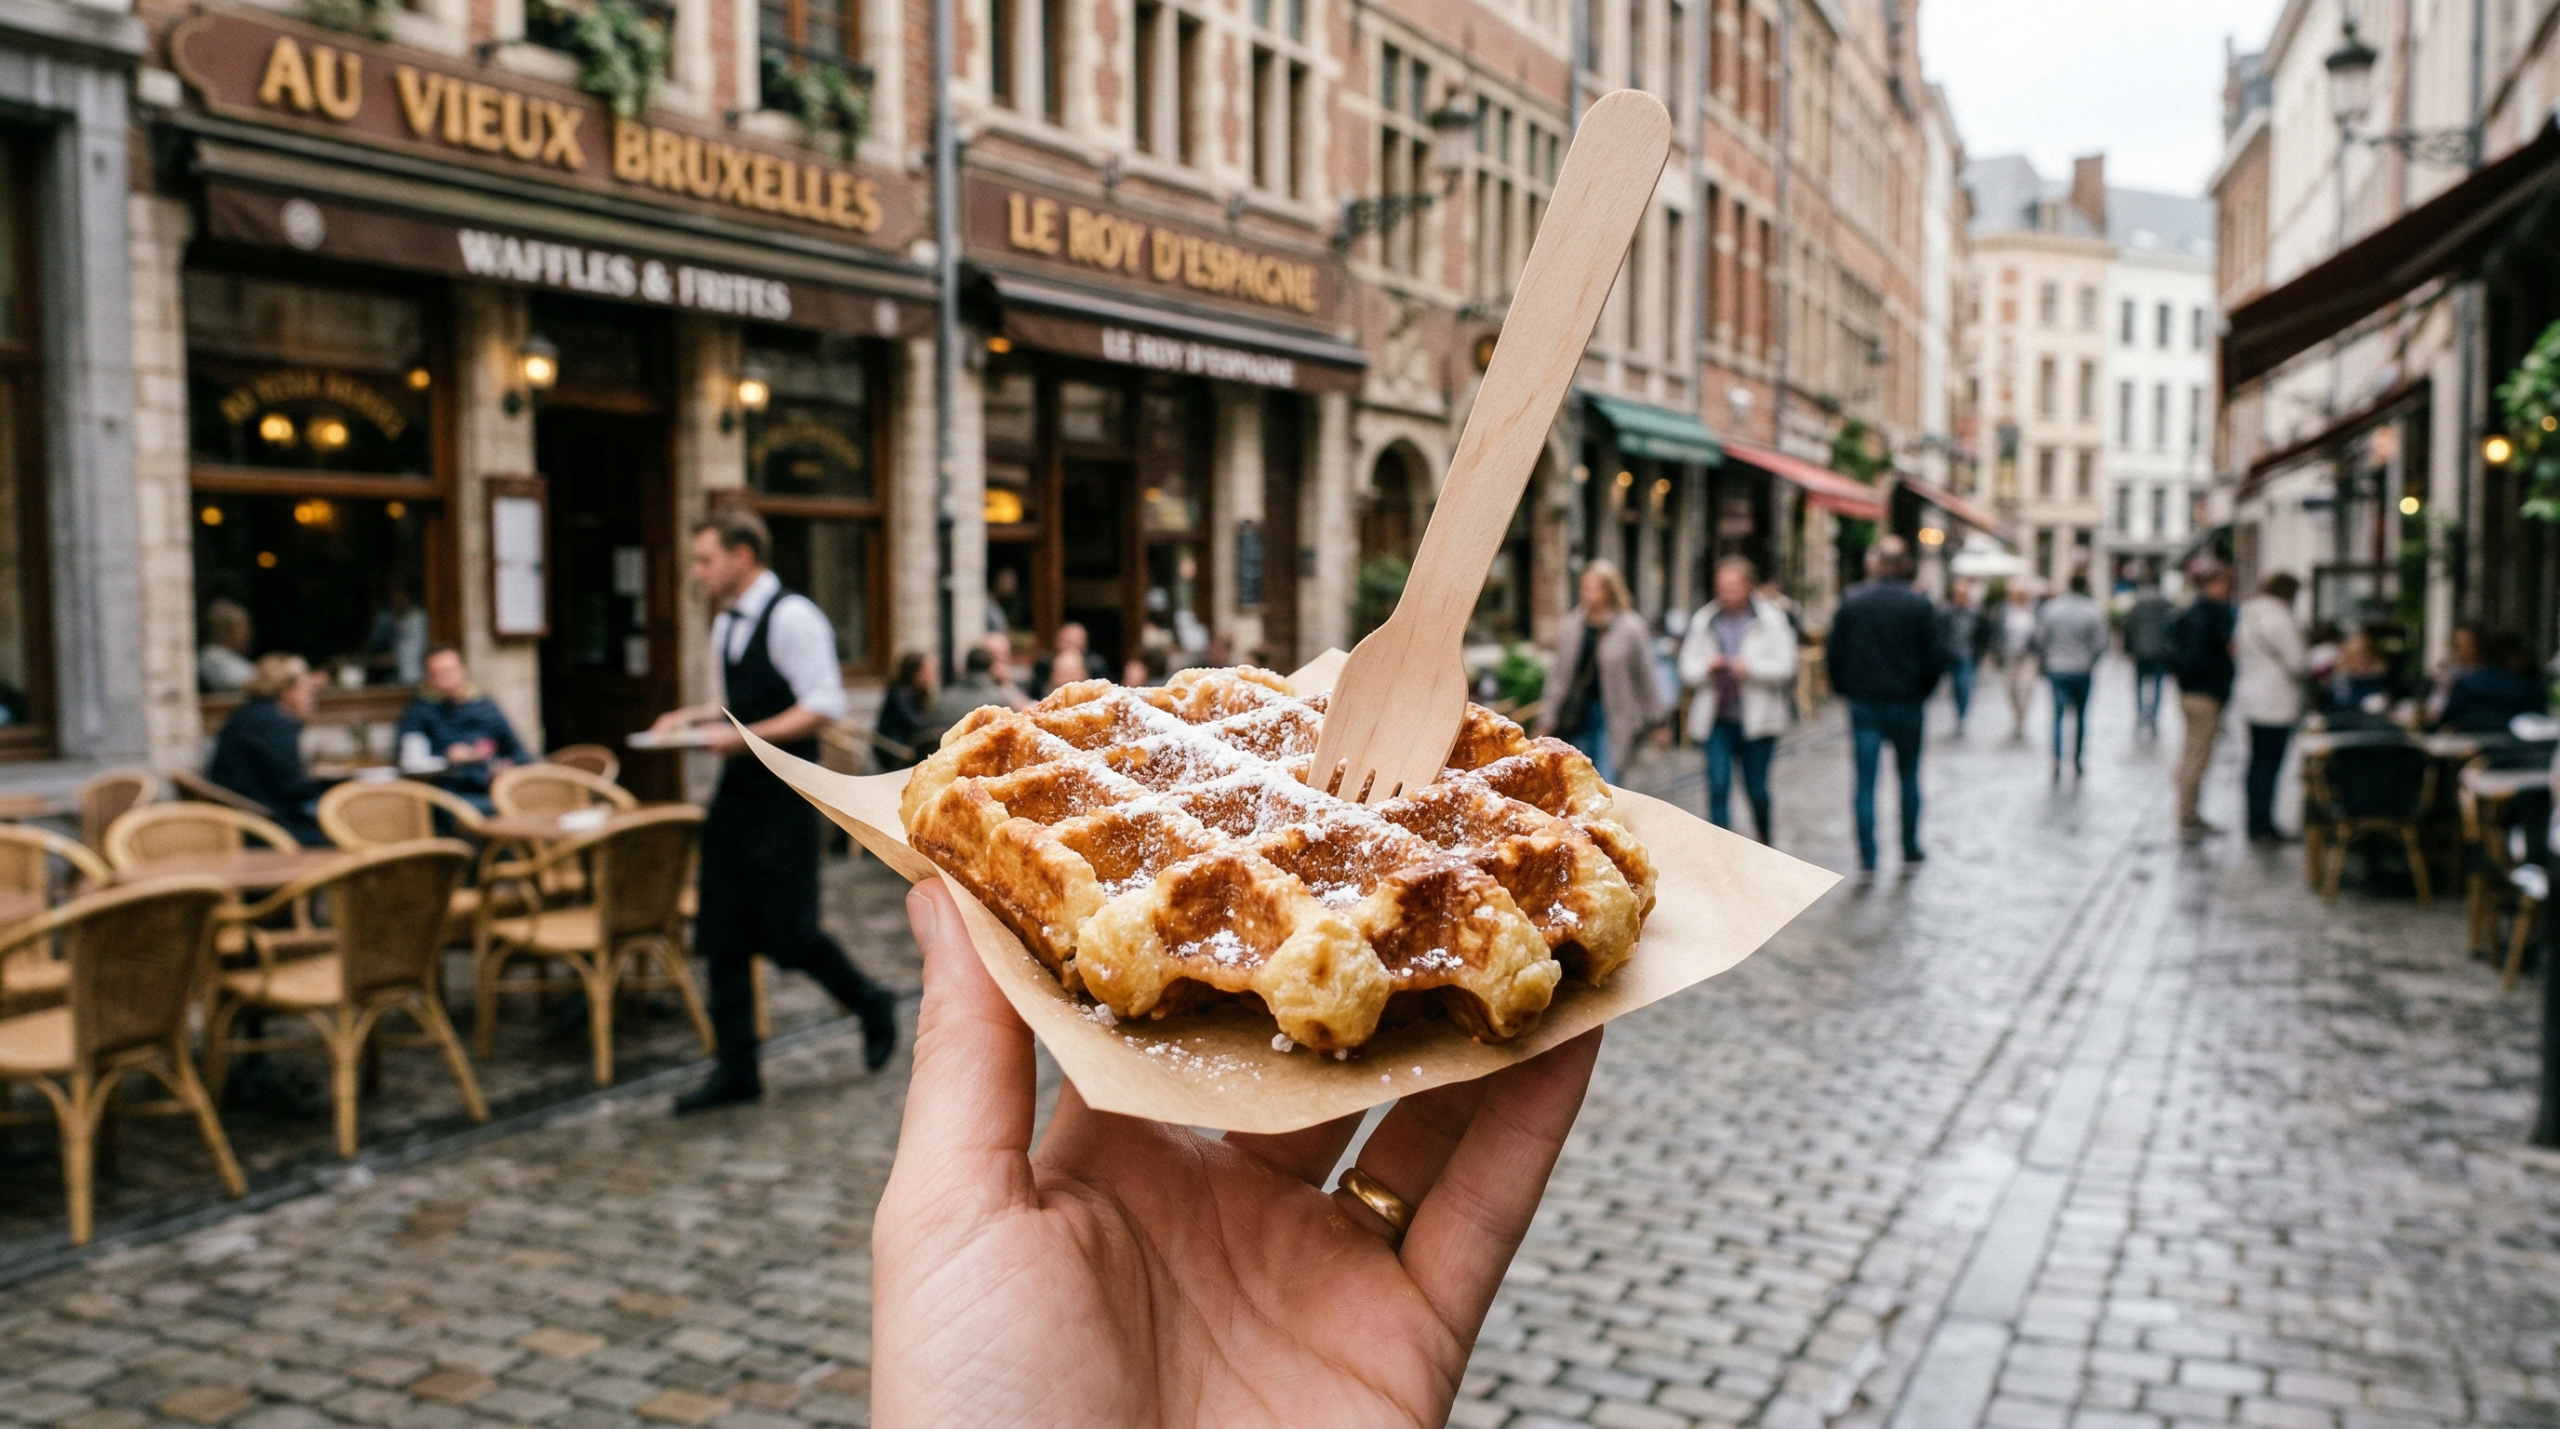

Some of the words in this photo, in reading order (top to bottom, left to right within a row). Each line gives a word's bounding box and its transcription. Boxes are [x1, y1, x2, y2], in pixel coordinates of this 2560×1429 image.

[258, 36, 362, 121] AU
[395, 65, 586, 170] VIEUX
[612, 117, 884, 234] BRUXELLES
[457, 229, 638, 298] WAFFLES
[640, 259, 674, 304] &
[677, 265, 793, 322] FRITES
[1009, 192, 1060, 254] LE
[1067, 205, 1147, 275] ROY
[1151, 227, 1318, 314] D'ESPAGNE
[1102, 326, 1131, 363] LE
